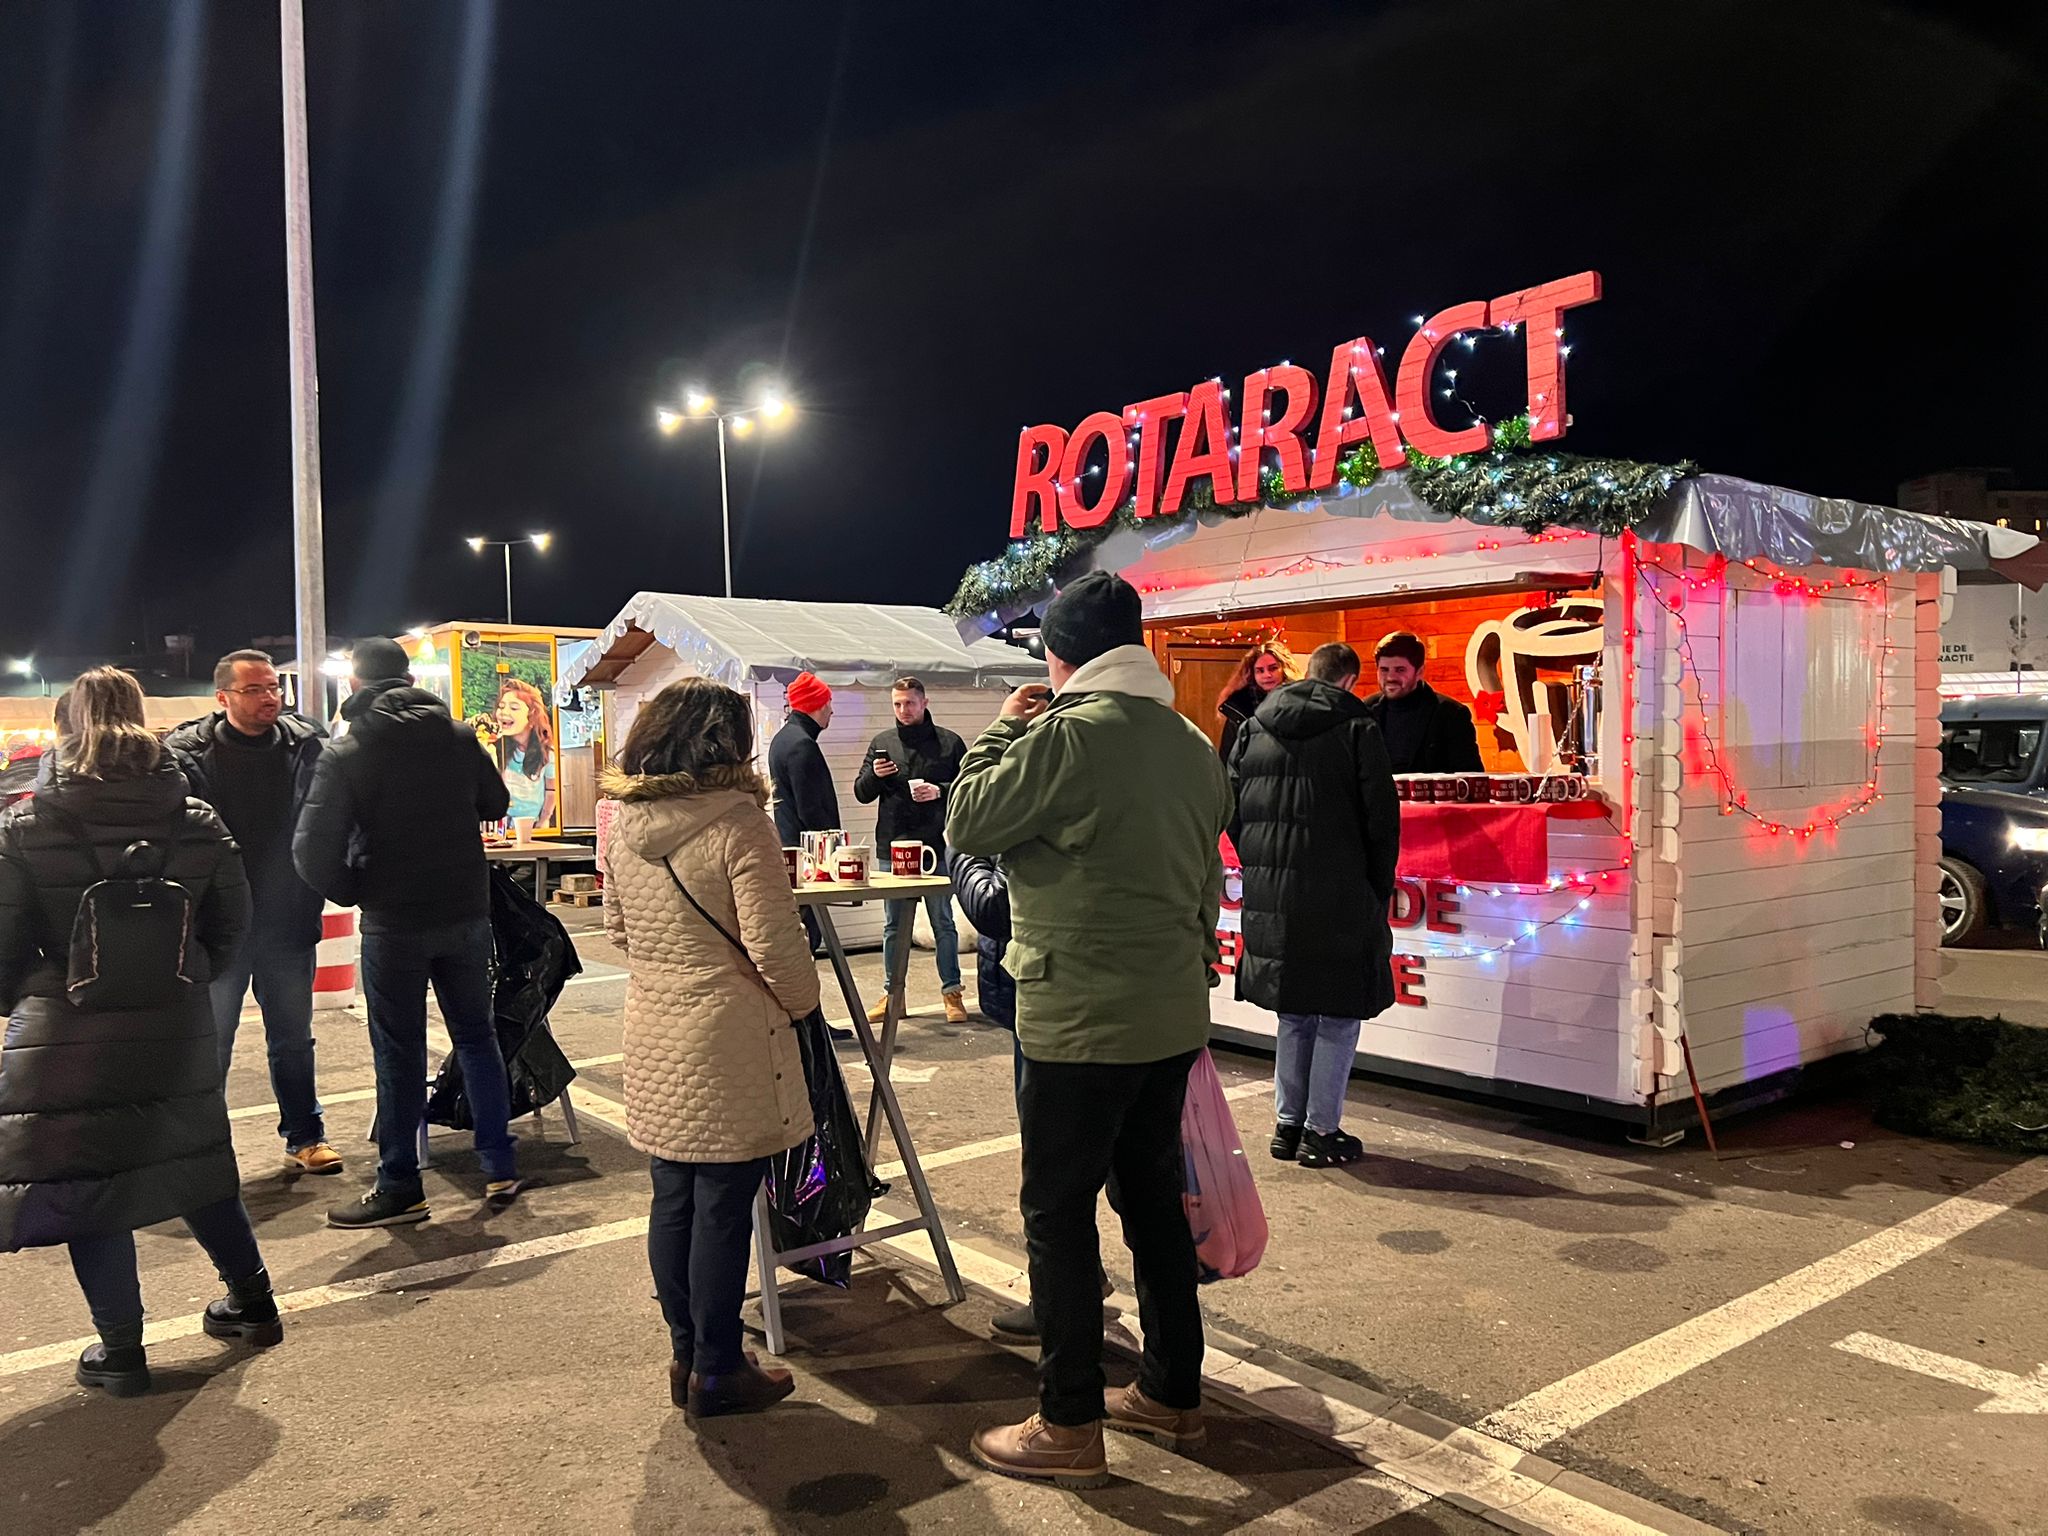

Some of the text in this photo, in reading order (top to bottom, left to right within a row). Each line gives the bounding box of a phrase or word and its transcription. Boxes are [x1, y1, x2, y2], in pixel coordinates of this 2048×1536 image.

[1010, 270, 1601, 538] ROTARACT
[1953, 644, 1967, 652] DE
[1387, 880, 1462, 935] DE
